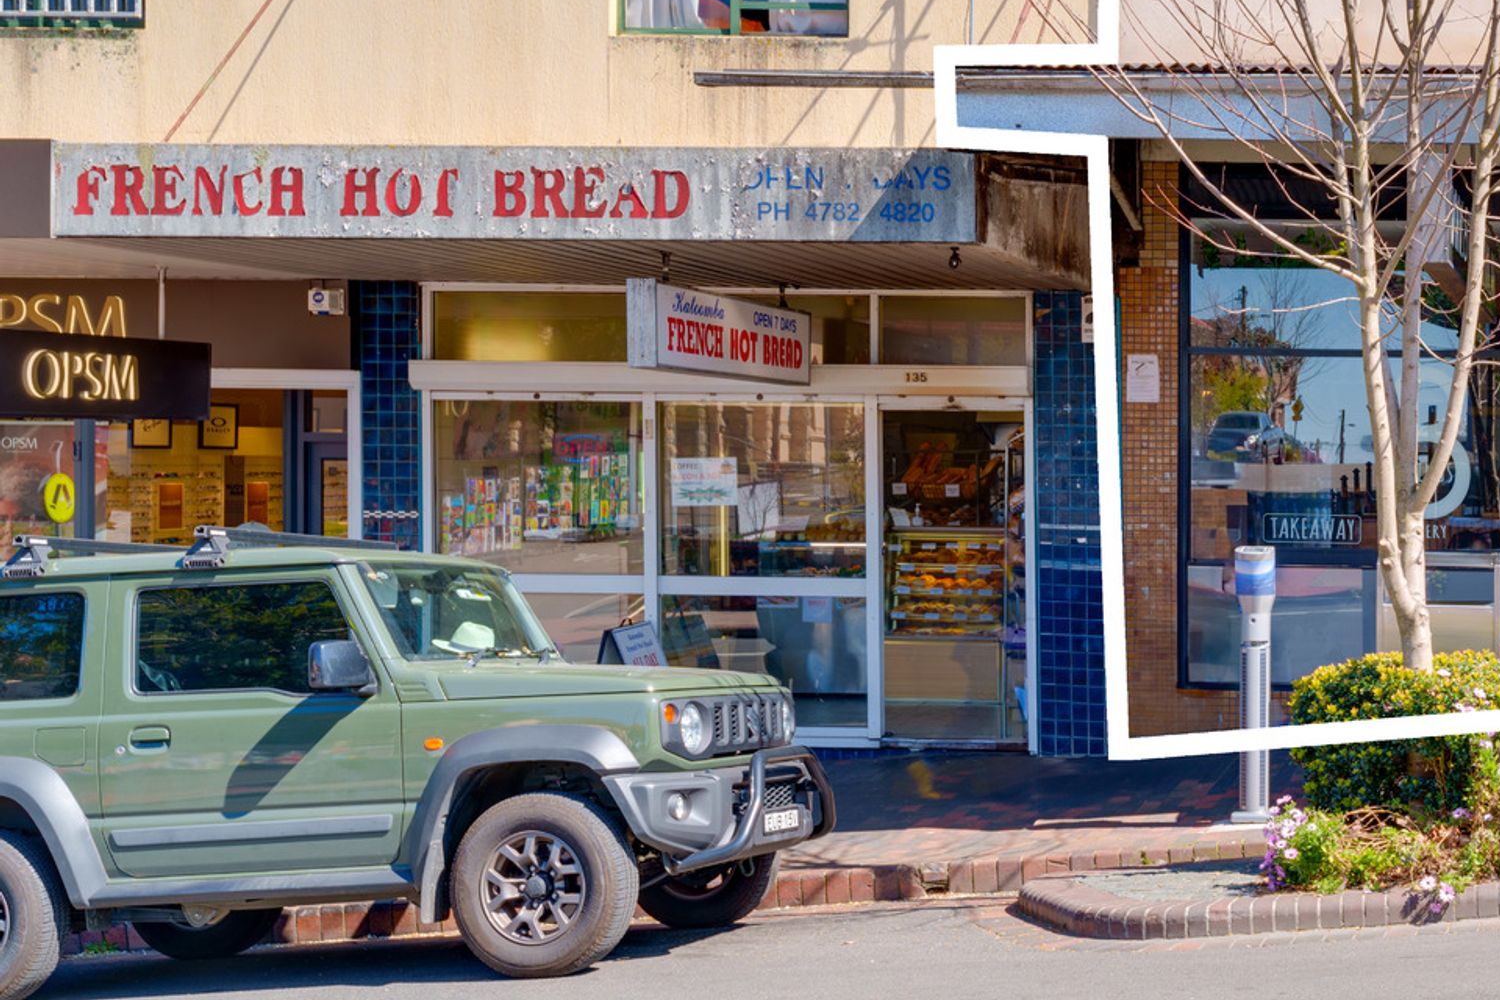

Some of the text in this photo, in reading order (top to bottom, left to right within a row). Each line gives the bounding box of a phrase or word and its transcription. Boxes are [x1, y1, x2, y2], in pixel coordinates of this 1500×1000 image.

[72, 164, 690, 219] FRENCH HOT BREAD
[757, 202, 935, 223] PH 4782 4820
[753, 311, 798, 333] OPEN 7 DAYS
[667, 316, 803, 370] FRENCH HOT BREAD
[23, 348, 139, 400] OPSM
[905, 371, 928, 383] 135
[1, 436, 38, 449] OPSM
[1270, 517, 1356, 541] TAKEAWAY
